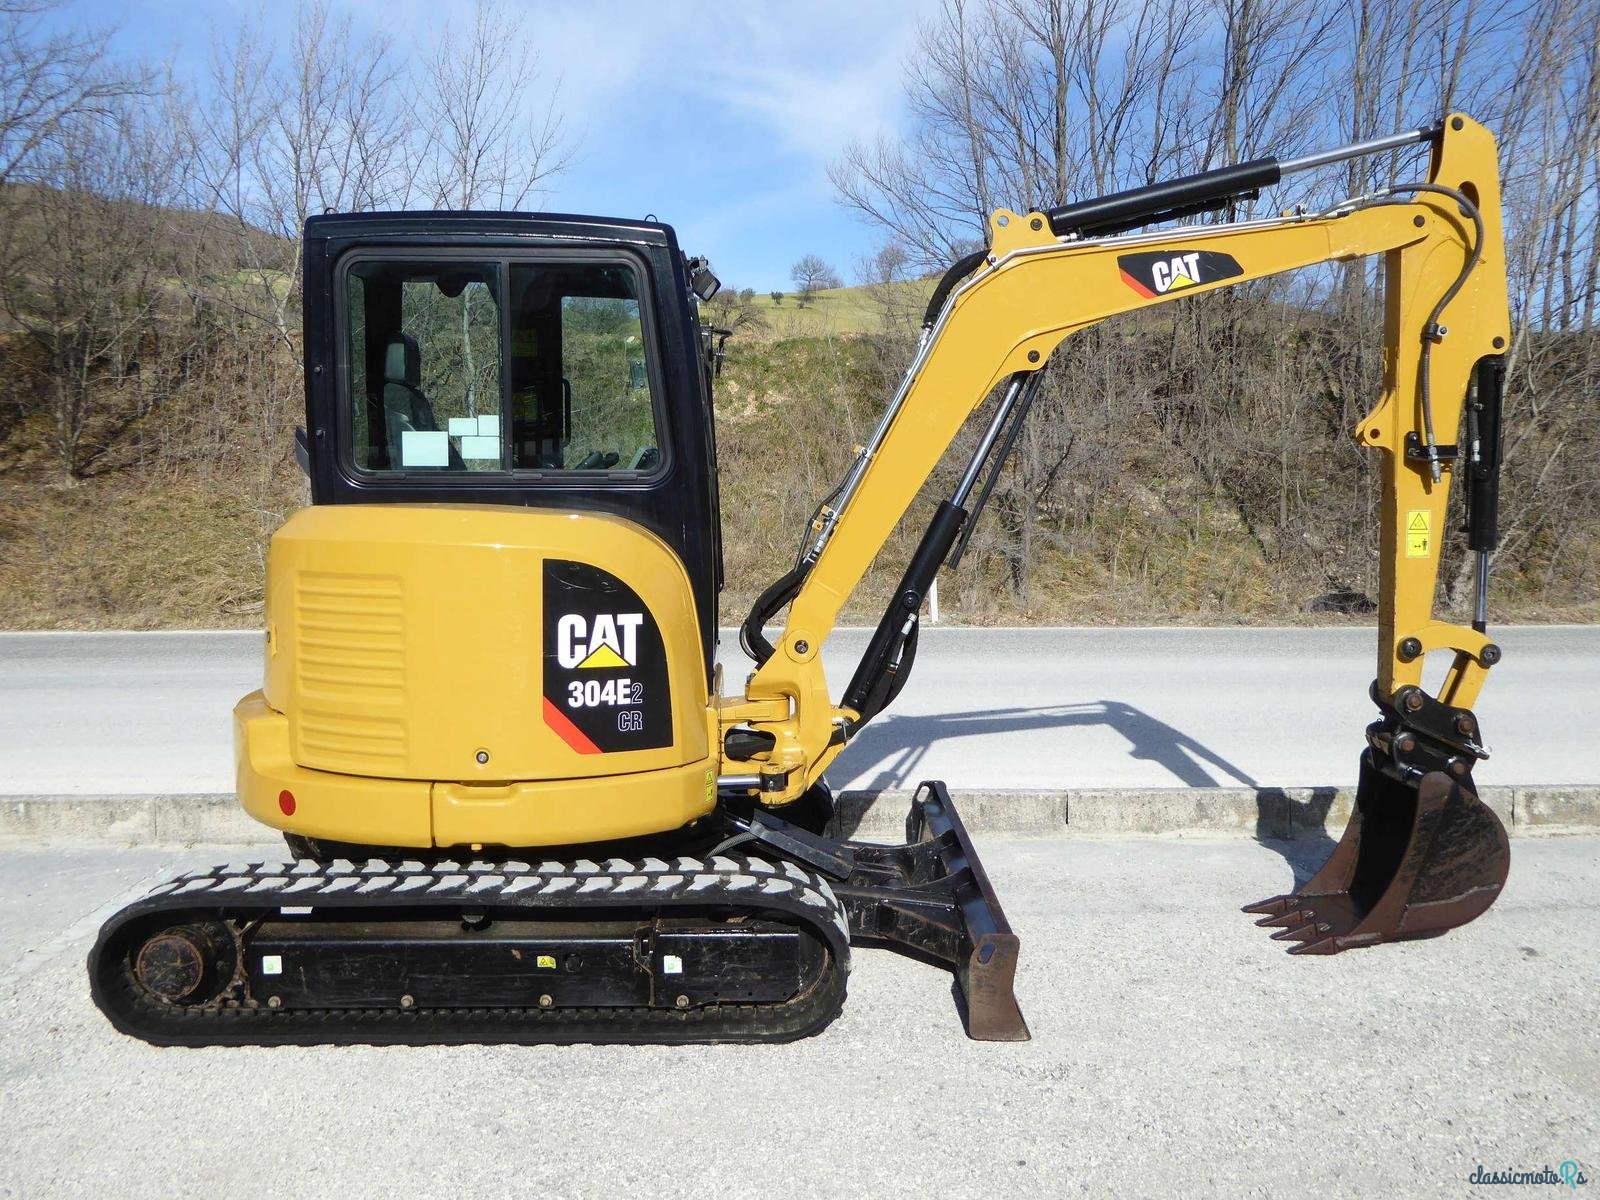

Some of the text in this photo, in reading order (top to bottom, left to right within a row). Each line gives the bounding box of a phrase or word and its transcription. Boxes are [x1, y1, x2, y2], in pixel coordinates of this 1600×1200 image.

[1151, 252, 1200, 292] CAT
[557, 613, 643, 669] CAT
[568, 678, 643, 708] 304E2
[617, 711, 643, 732] CR
